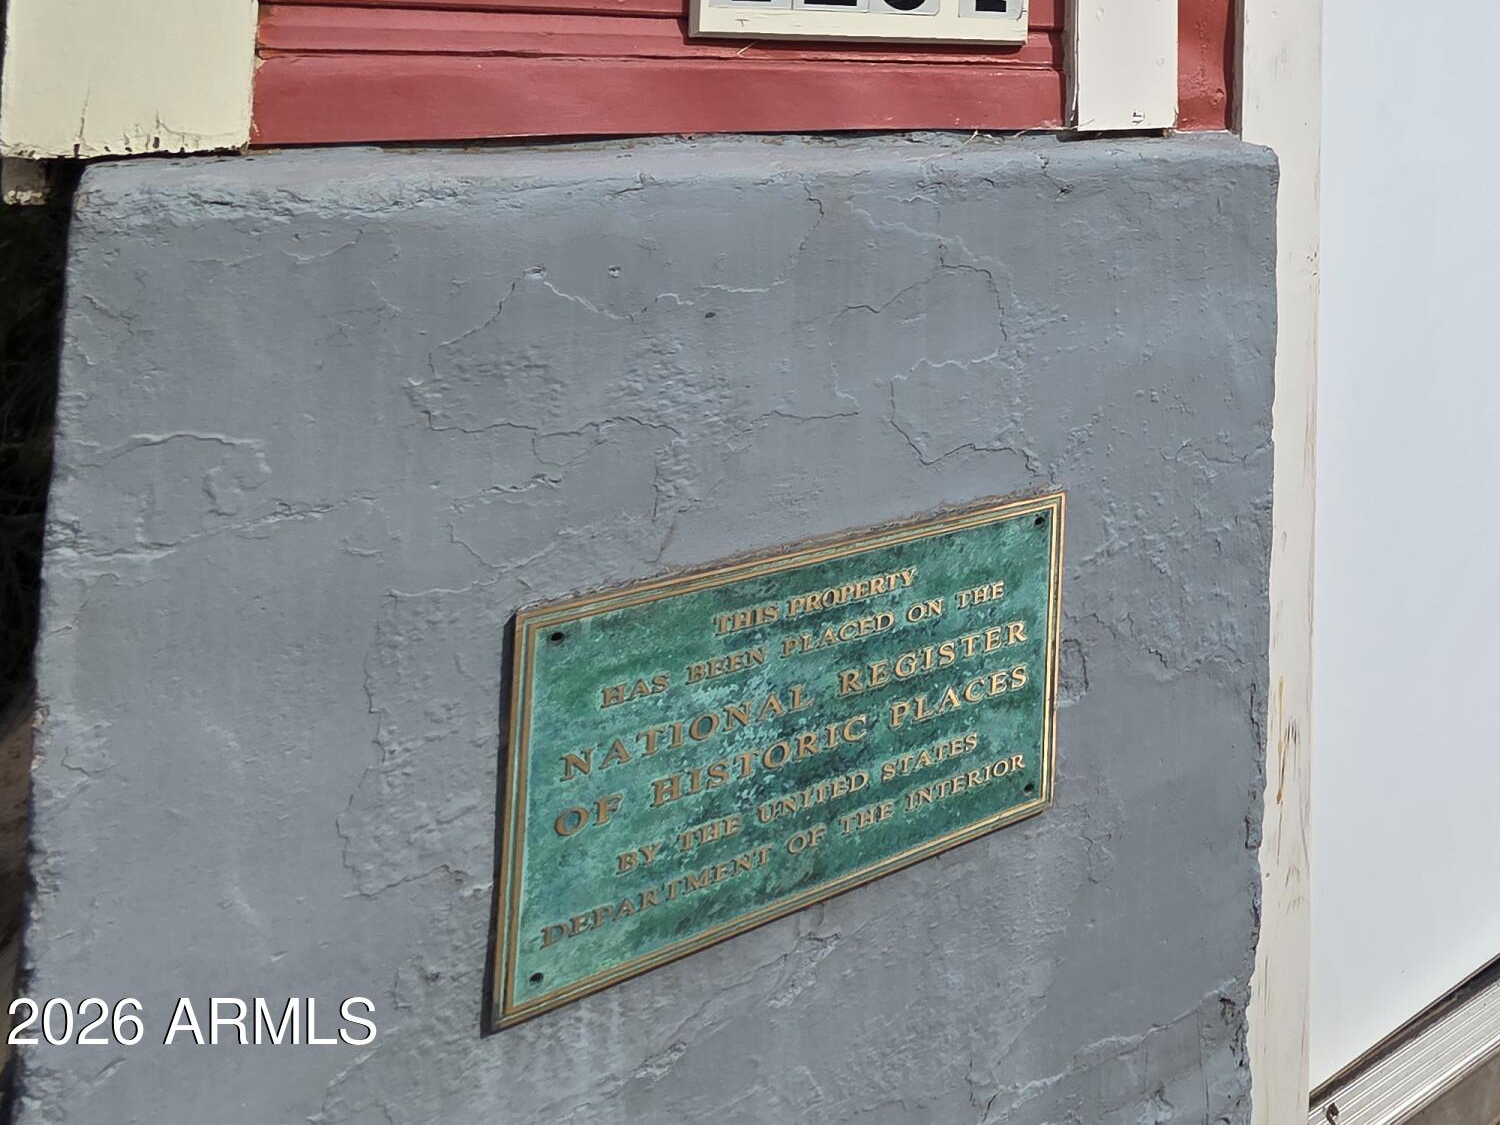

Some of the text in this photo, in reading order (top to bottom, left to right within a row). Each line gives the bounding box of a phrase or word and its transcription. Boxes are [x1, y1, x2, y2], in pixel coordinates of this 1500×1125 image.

[601, 581, 1005, 708] HAS BEEN PLACED ON THE
[714, 566, 918, 636] THIS PROPERTY
[554, 665, 1029, 837] OF HISTORIC PLACES
[560, 620, 1028, 782] NATIONAL REGISTER
[540, 754, 1026, 950] DEPARTMENT OF THE INTERIOR
[616, 732, 978, 875] BY THE UNITED STATES
